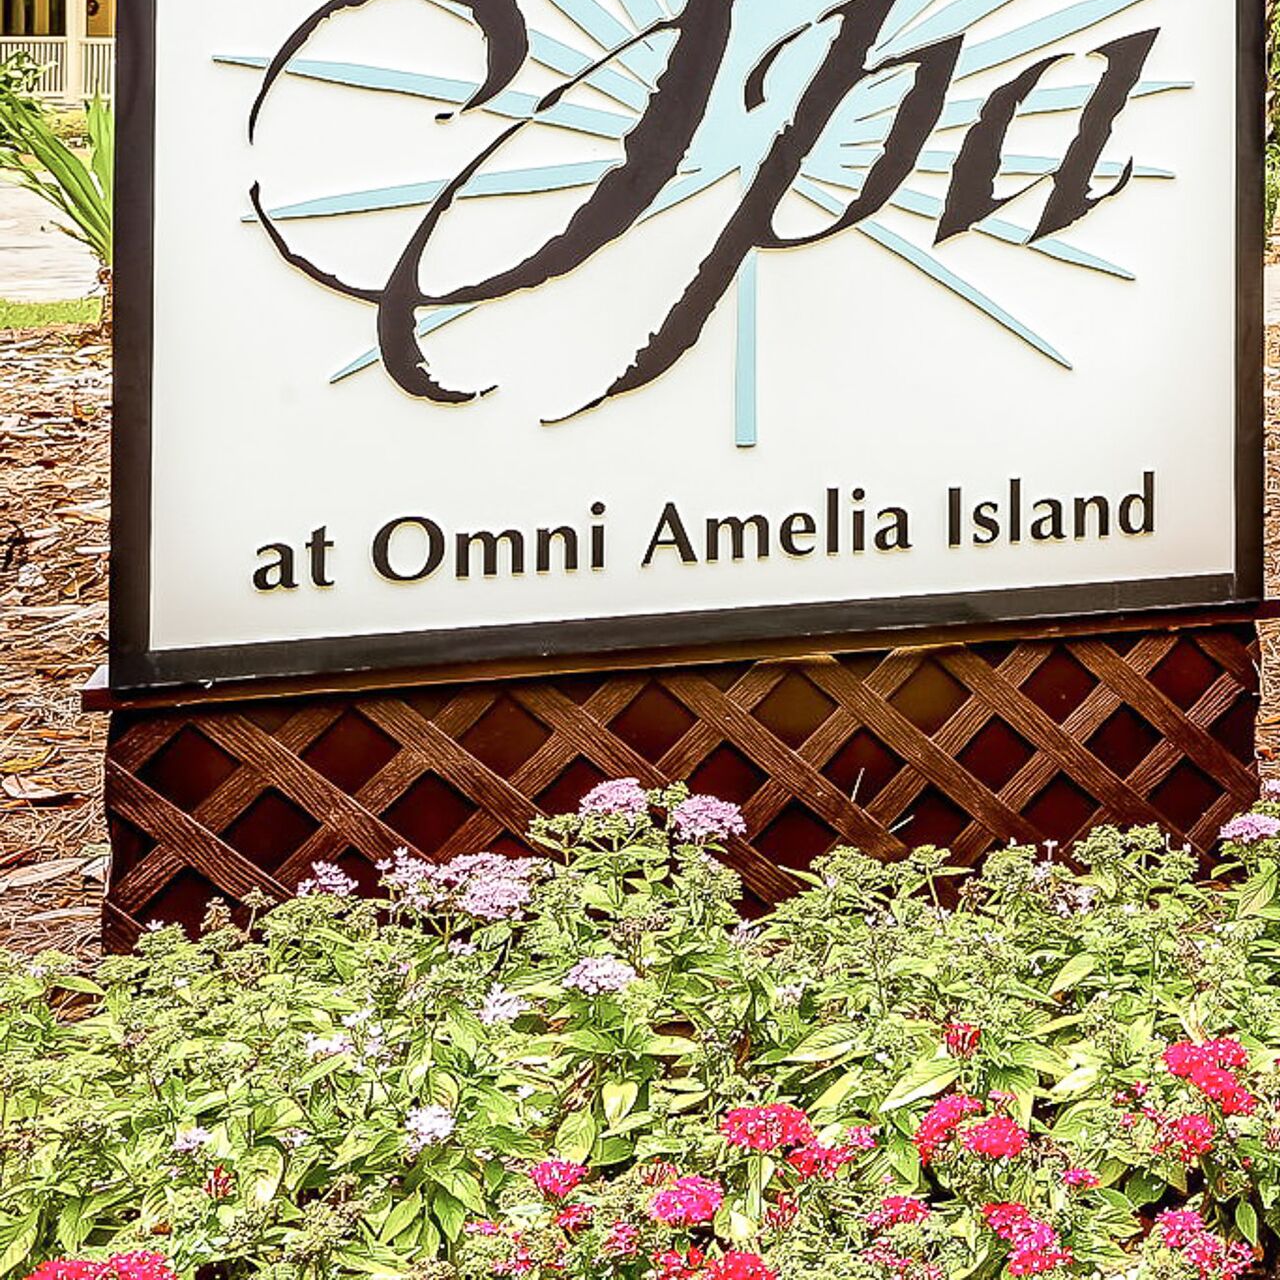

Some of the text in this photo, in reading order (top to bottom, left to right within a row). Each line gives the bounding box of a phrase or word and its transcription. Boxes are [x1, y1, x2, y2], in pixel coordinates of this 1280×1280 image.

[252, 471, 1156, 591] at Omni Amelia Island
